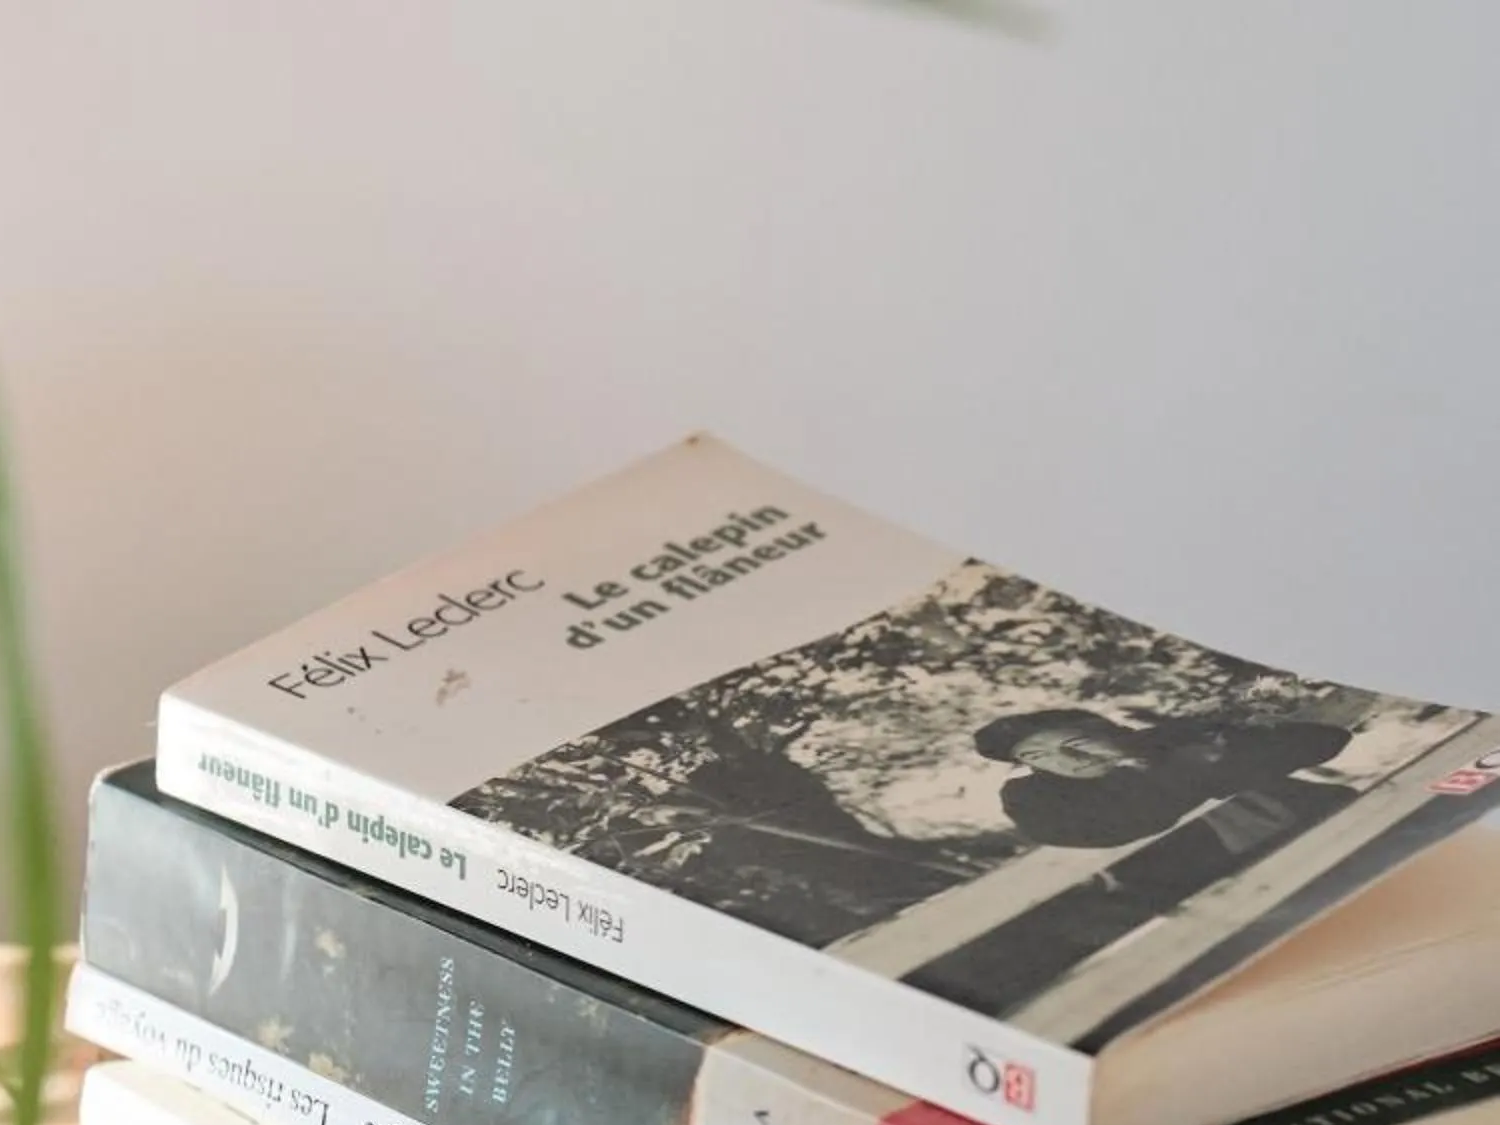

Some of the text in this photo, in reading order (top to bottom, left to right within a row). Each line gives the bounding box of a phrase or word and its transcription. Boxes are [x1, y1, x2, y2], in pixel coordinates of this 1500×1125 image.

[561, 504, 790, 610] Le calepin
[565, 520, 827, 650] d'un flâneur
[267, 568, 546, 699] Félix Leclerc
[197, 752, 467, 881] Le calepin d'un flâneur
[496, 867, 625, 945] Félix Leclerc
[176, 1037, 202, 1073] du
[208, 1057, 284, 1109] risques
[424, 956, 455, 1114] SWEETNESS
[459, 999, 486, 1096] IN THE
[491, 1017, 516, 1104] BELLY
